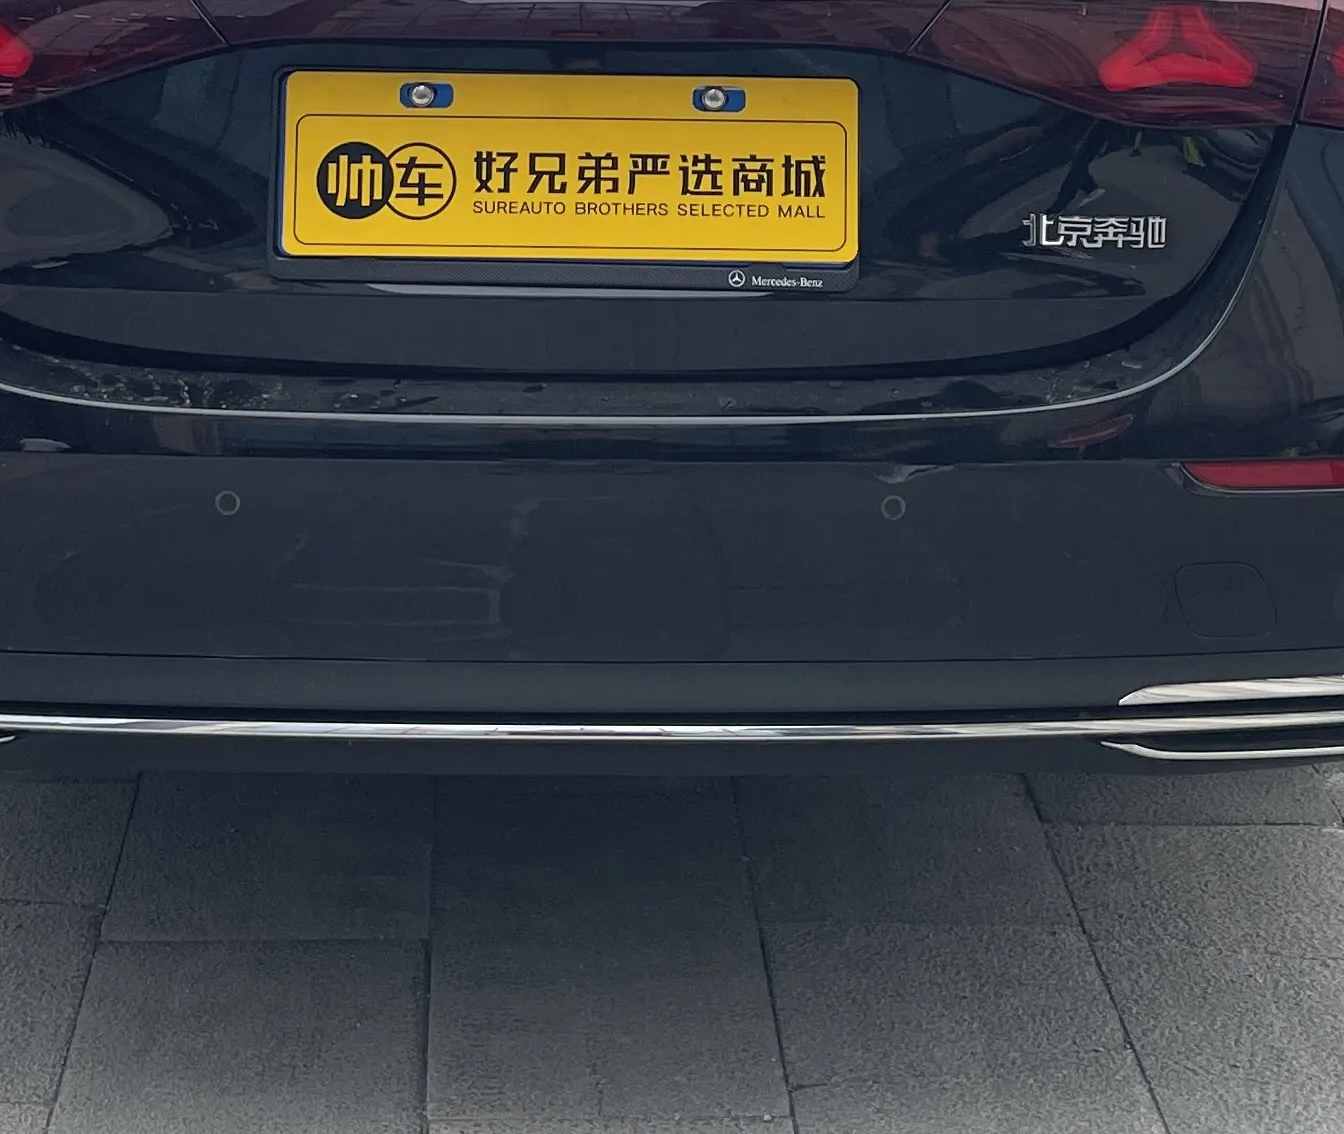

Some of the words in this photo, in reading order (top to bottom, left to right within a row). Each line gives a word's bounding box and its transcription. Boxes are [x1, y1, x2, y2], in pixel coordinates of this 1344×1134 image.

[473, 150, 827, 198] 好兄弟严选商城
[472, 201, 566, 215] SUREAUTO
[575, 202, 668, 216] BROTHERS
[677, 203, 769, 218] SELECTED
[778, 204, 826, 219] MALL
[1022, 214, 1167, 249] 北京奔驰
[751, 275, 823, 287] Mercedes-Benz
